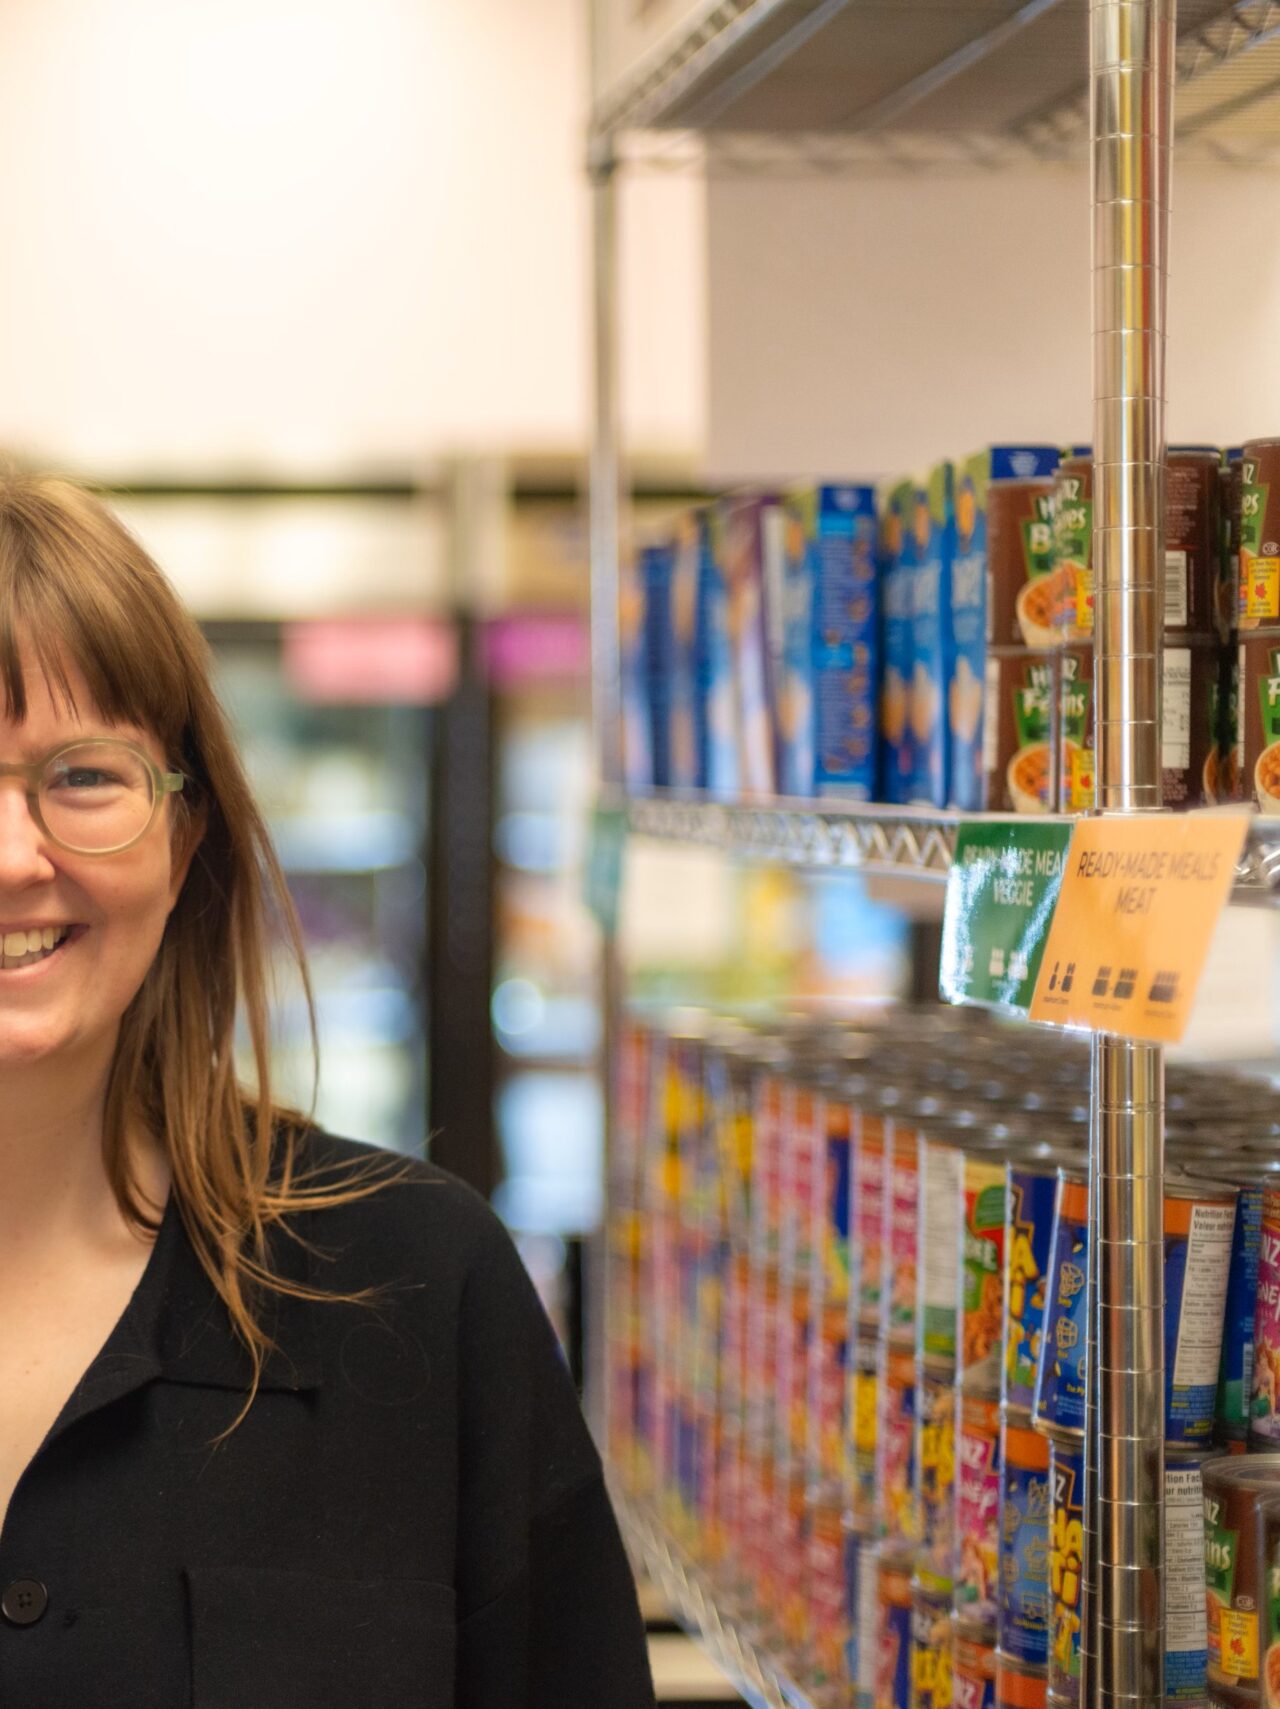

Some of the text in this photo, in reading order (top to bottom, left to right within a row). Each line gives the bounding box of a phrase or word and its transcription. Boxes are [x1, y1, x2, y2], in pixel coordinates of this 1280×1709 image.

[1077, 851, 1223, 881] READY-MADE MEALS
[993, 877, 1033, 907] VEGGIE
[1114, 886, 1157, 915] MEAT
